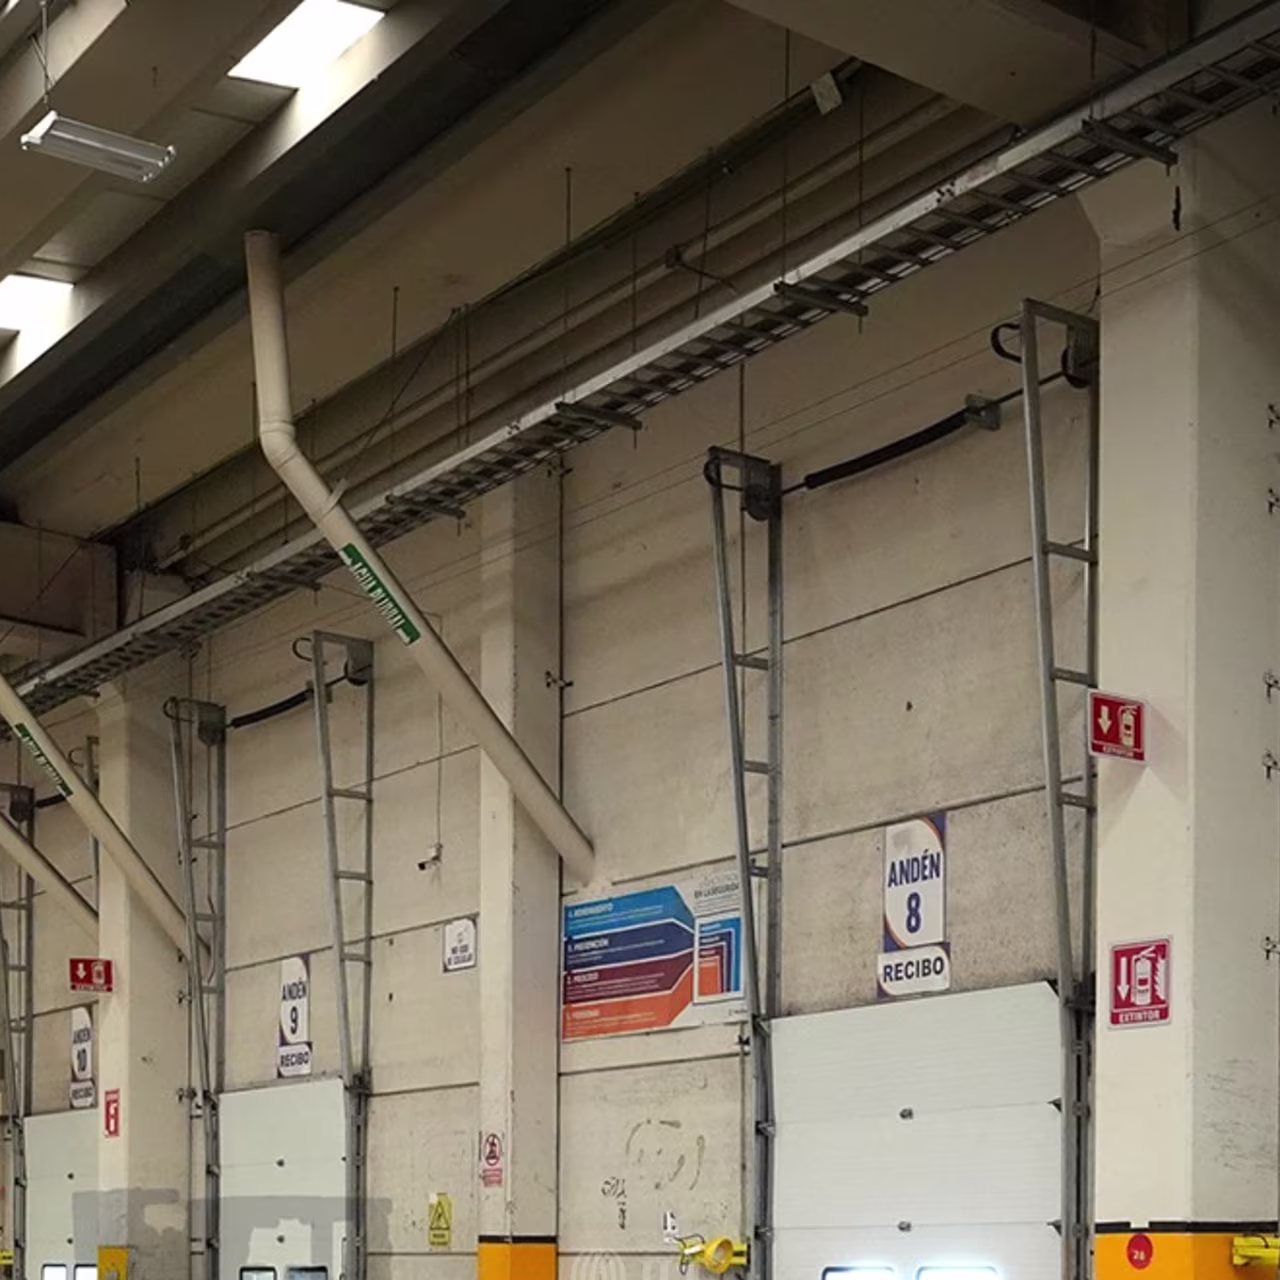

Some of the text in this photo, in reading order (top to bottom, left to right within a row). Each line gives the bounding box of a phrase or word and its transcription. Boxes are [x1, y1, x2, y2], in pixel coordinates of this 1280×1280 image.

[888, 849, 940, 887] ANDÉN
[906, 892, 921, 933] 8
[883, 957, 944, 982] RECIBO
[290, 1006, 298, 1035] 9
